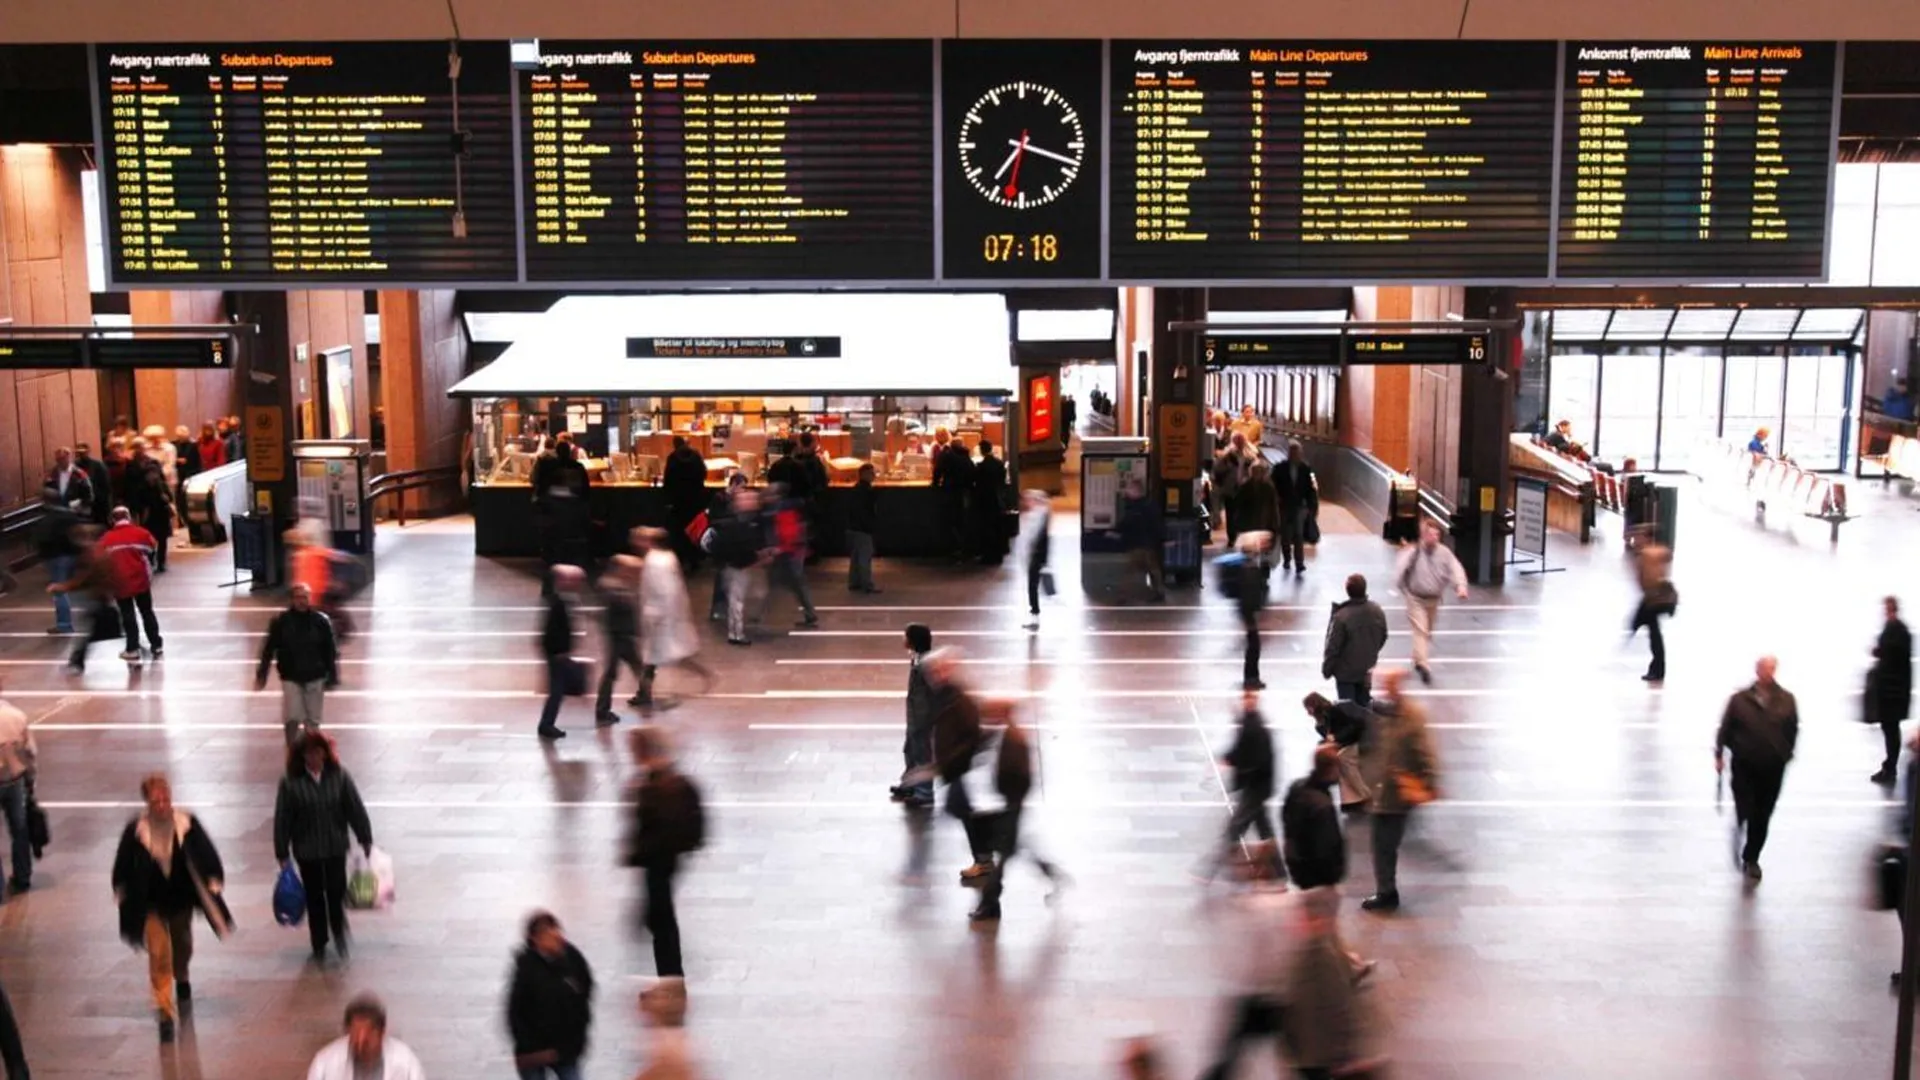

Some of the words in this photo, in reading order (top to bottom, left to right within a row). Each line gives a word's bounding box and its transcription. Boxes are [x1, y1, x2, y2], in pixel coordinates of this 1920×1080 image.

[538, 54, 574, 67] vgang
[575, 52, 632, 65] nærtrafikk
[642, 52, 695, 65] Suburban
[696, 52, 755, 66] Departures
[1134, 49, 1178, 64] Avgang
[1179, 49, 1240, 64] fjerntrafikk
[1249, 50, 1278, 62] Main
[1280, 50, 1304, 62] Line
[1305, 50, 1368, 63] Departures
[1577, 48, 1629, 61] Ankomst
[1630, 47, 1691, 62] fjerntrafikk
[1703, 47, 1733, 60] Main
[1734, 47, 1759, 60] Line
[1760, 47, 1802, 59] Arrivals
[109, 55, 152, 69] Avgang
[154, 53, 211, 67] nærtrafikk
[220, 54, 273, 67] Suburban
[274, 54, 334, 68] Departures
[1711, 87, 1716, 99] 1
[212, 120, 222, 130] 11
[632, 118, 642, 129] 11
[637, 131, 643, 142] 7
[1704, 126, 1714, 137] 11
[218, 133, 223, 143] 7
[221, 184, 226, 194] 7
[639, 182, 644, 193] 7
[1250, 179, 1260, 190] 11
[1701, 178, 1712, 189] 11
[1249, 231, 1259, 241] 11
[1699, 229, 1709, 240] 11
[984, 234, 1058, 262] 07:18
[213, 351, 223, 364] 8
[1205, 349, 1214, 362] 9
[1469, 346, 1484, 361] 10
